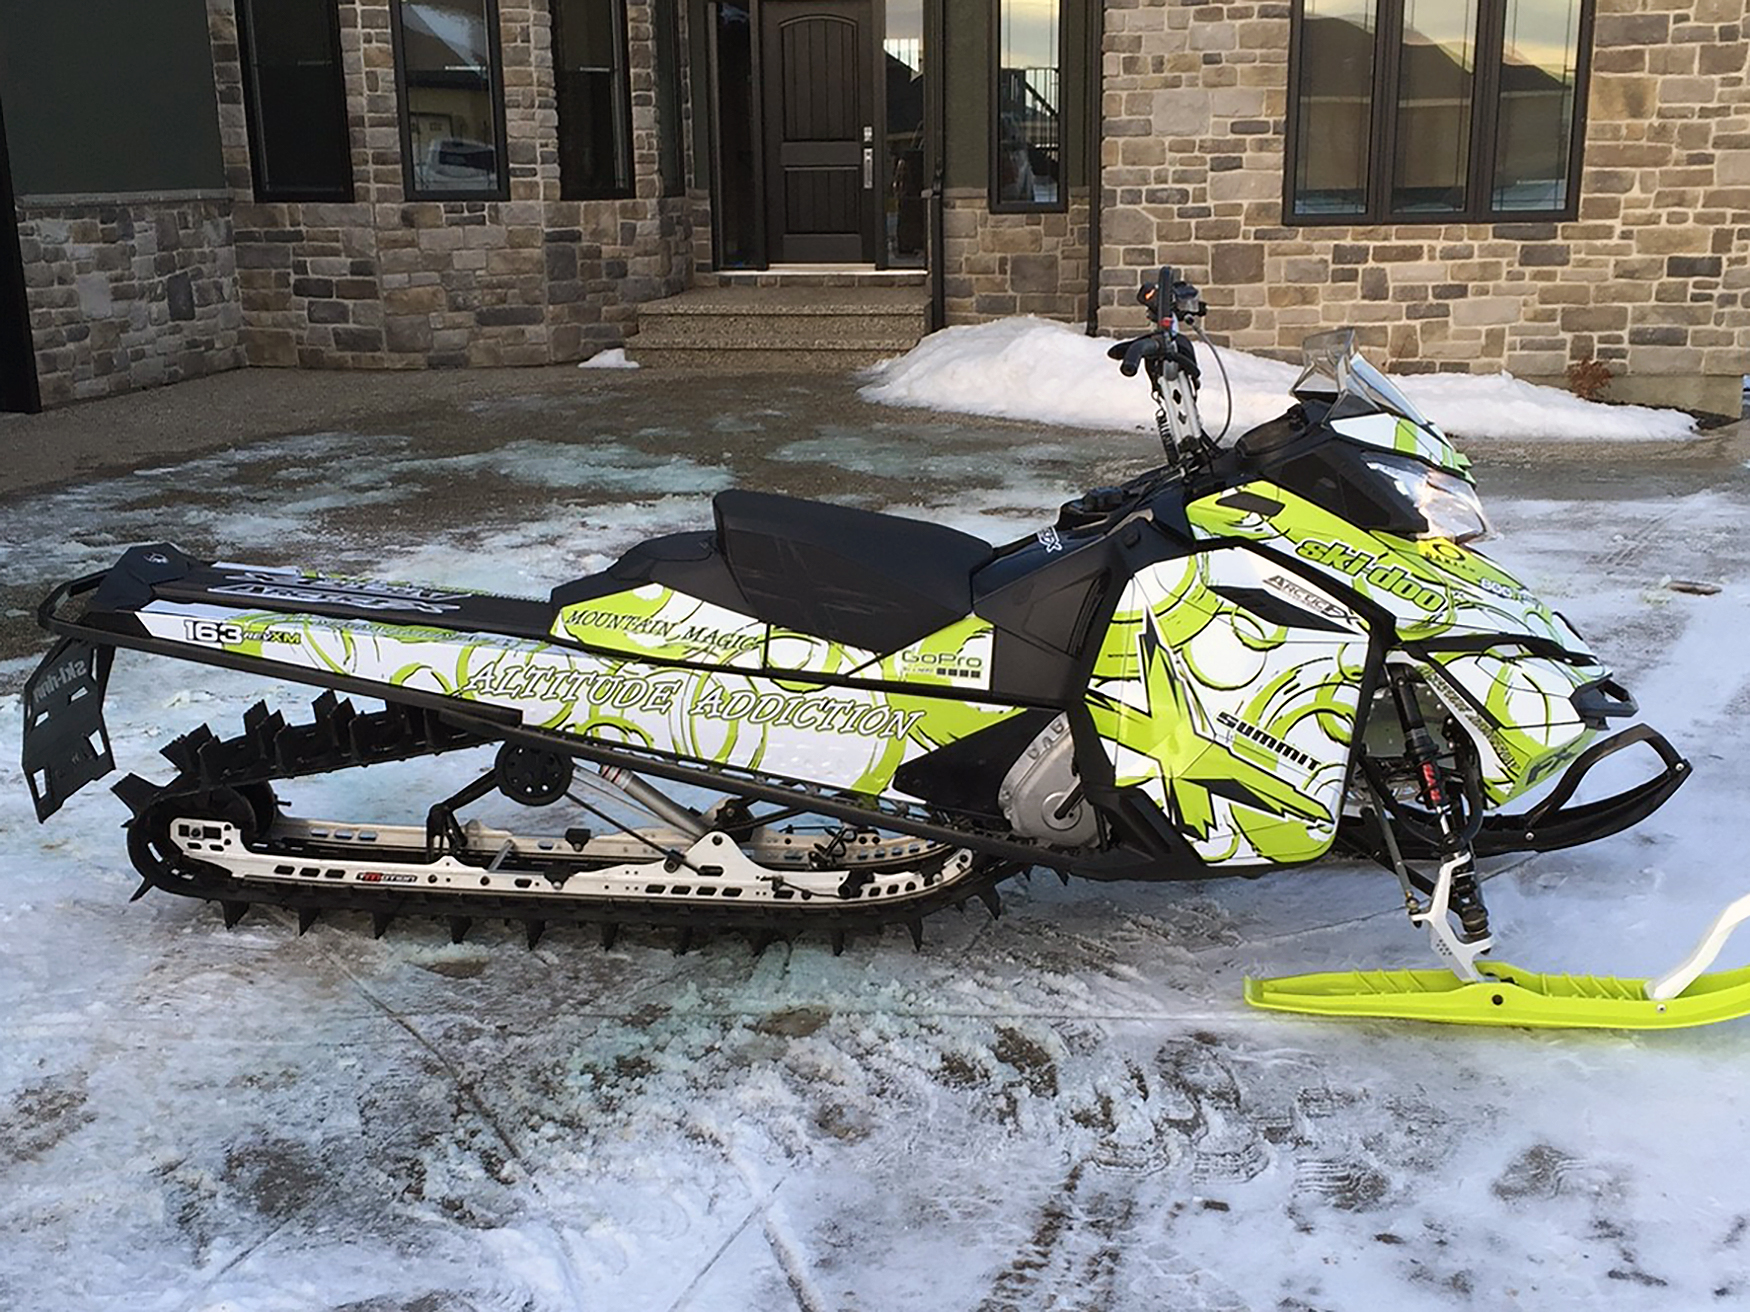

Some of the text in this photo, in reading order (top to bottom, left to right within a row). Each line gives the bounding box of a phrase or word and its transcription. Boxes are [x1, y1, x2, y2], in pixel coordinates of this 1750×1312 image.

[183, 619, 244, 645] 163
[565, 610, 680, 637] MOUNTAIN
[901, 650, 983, 668] GoPro
[461, 660, 927, 741] ALTITUDE ADDICTION
